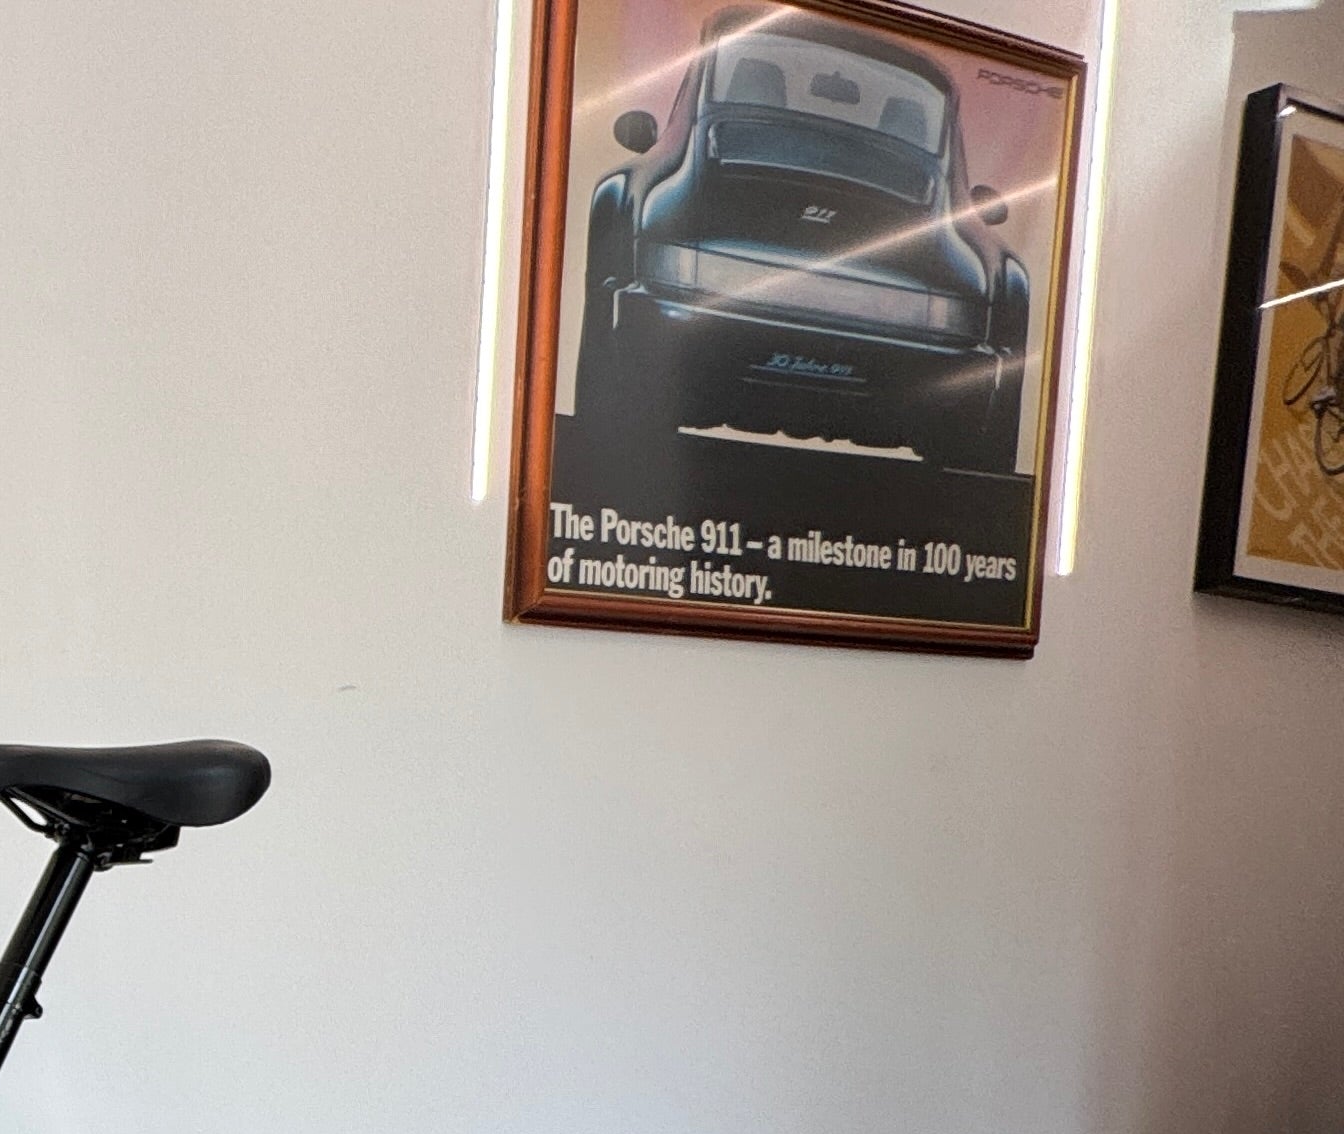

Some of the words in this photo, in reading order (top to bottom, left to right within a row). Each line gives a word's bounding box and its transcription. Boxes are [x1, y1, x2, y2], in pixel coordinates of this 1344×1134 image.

[549, 502, 594, 541] The
[600, 508, 695, 551] Porsche
[701, 519, 743, 556] 911
[767, 535, 782, 560] a
[787, 531, 892, 570] milestone
[897, 538, 916, 572] in
[922, 541, 961, 576] 100
[963, 553, 1017, 582] years
[547, 548, 575, 583] of
[579, 554, 685, 598] motoring
[690, 560, 772, 605] history.
